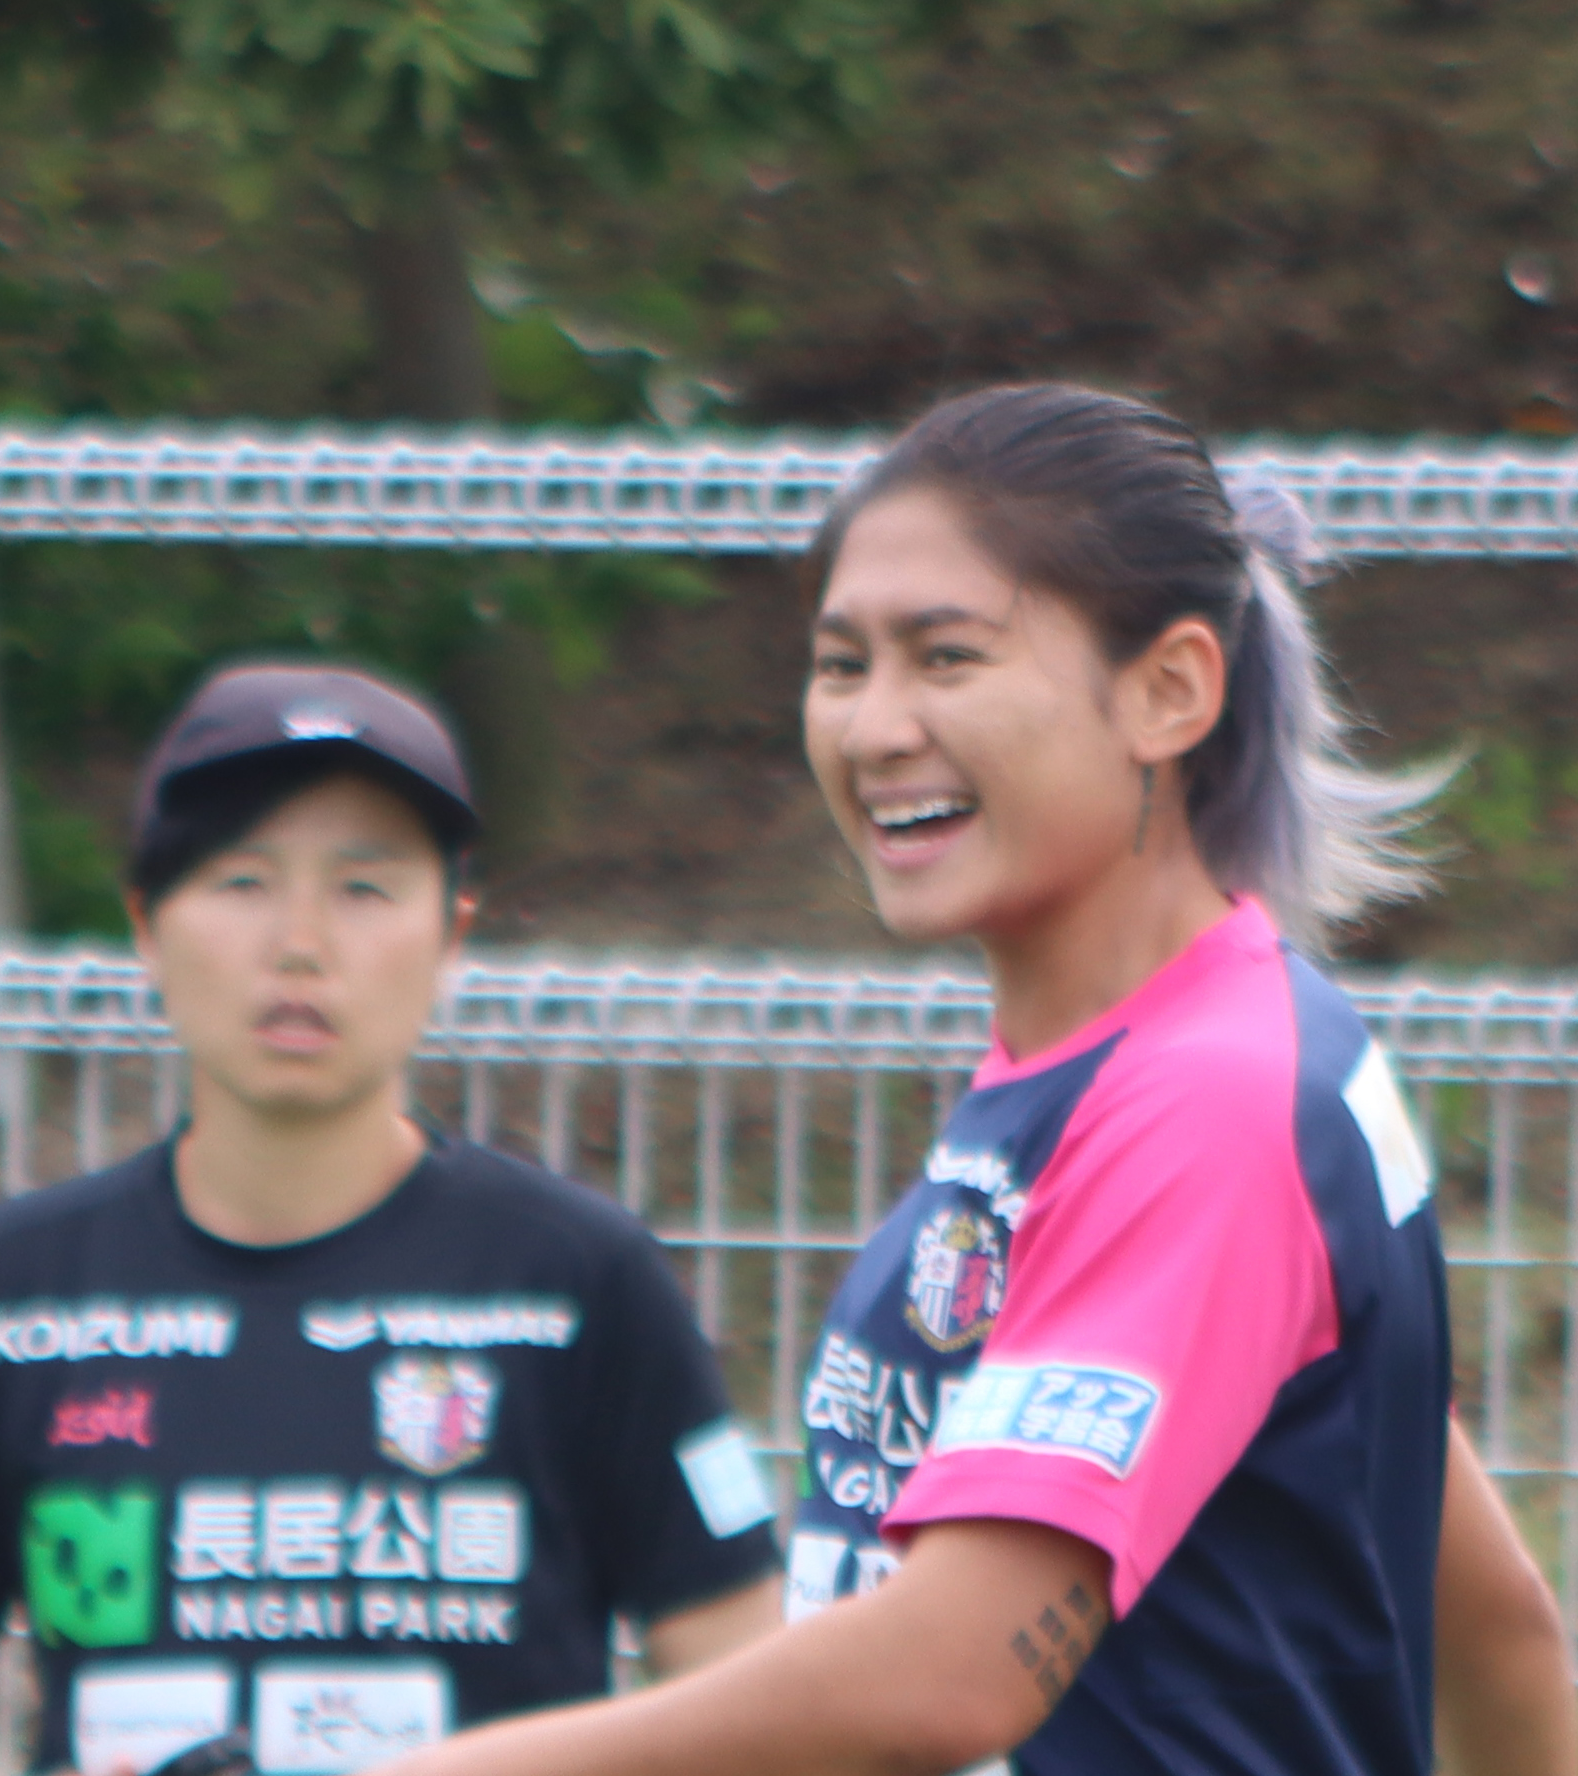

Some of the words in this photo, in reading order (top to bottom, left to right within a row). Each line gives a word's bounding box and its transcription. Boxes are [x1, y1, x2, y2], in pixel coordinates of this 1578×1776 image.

[174, 1488, 528, 1583] 長居公園
[175, 1592, 343, 1641] NAGAI
[360, 1594, 516, 1643] PARK
